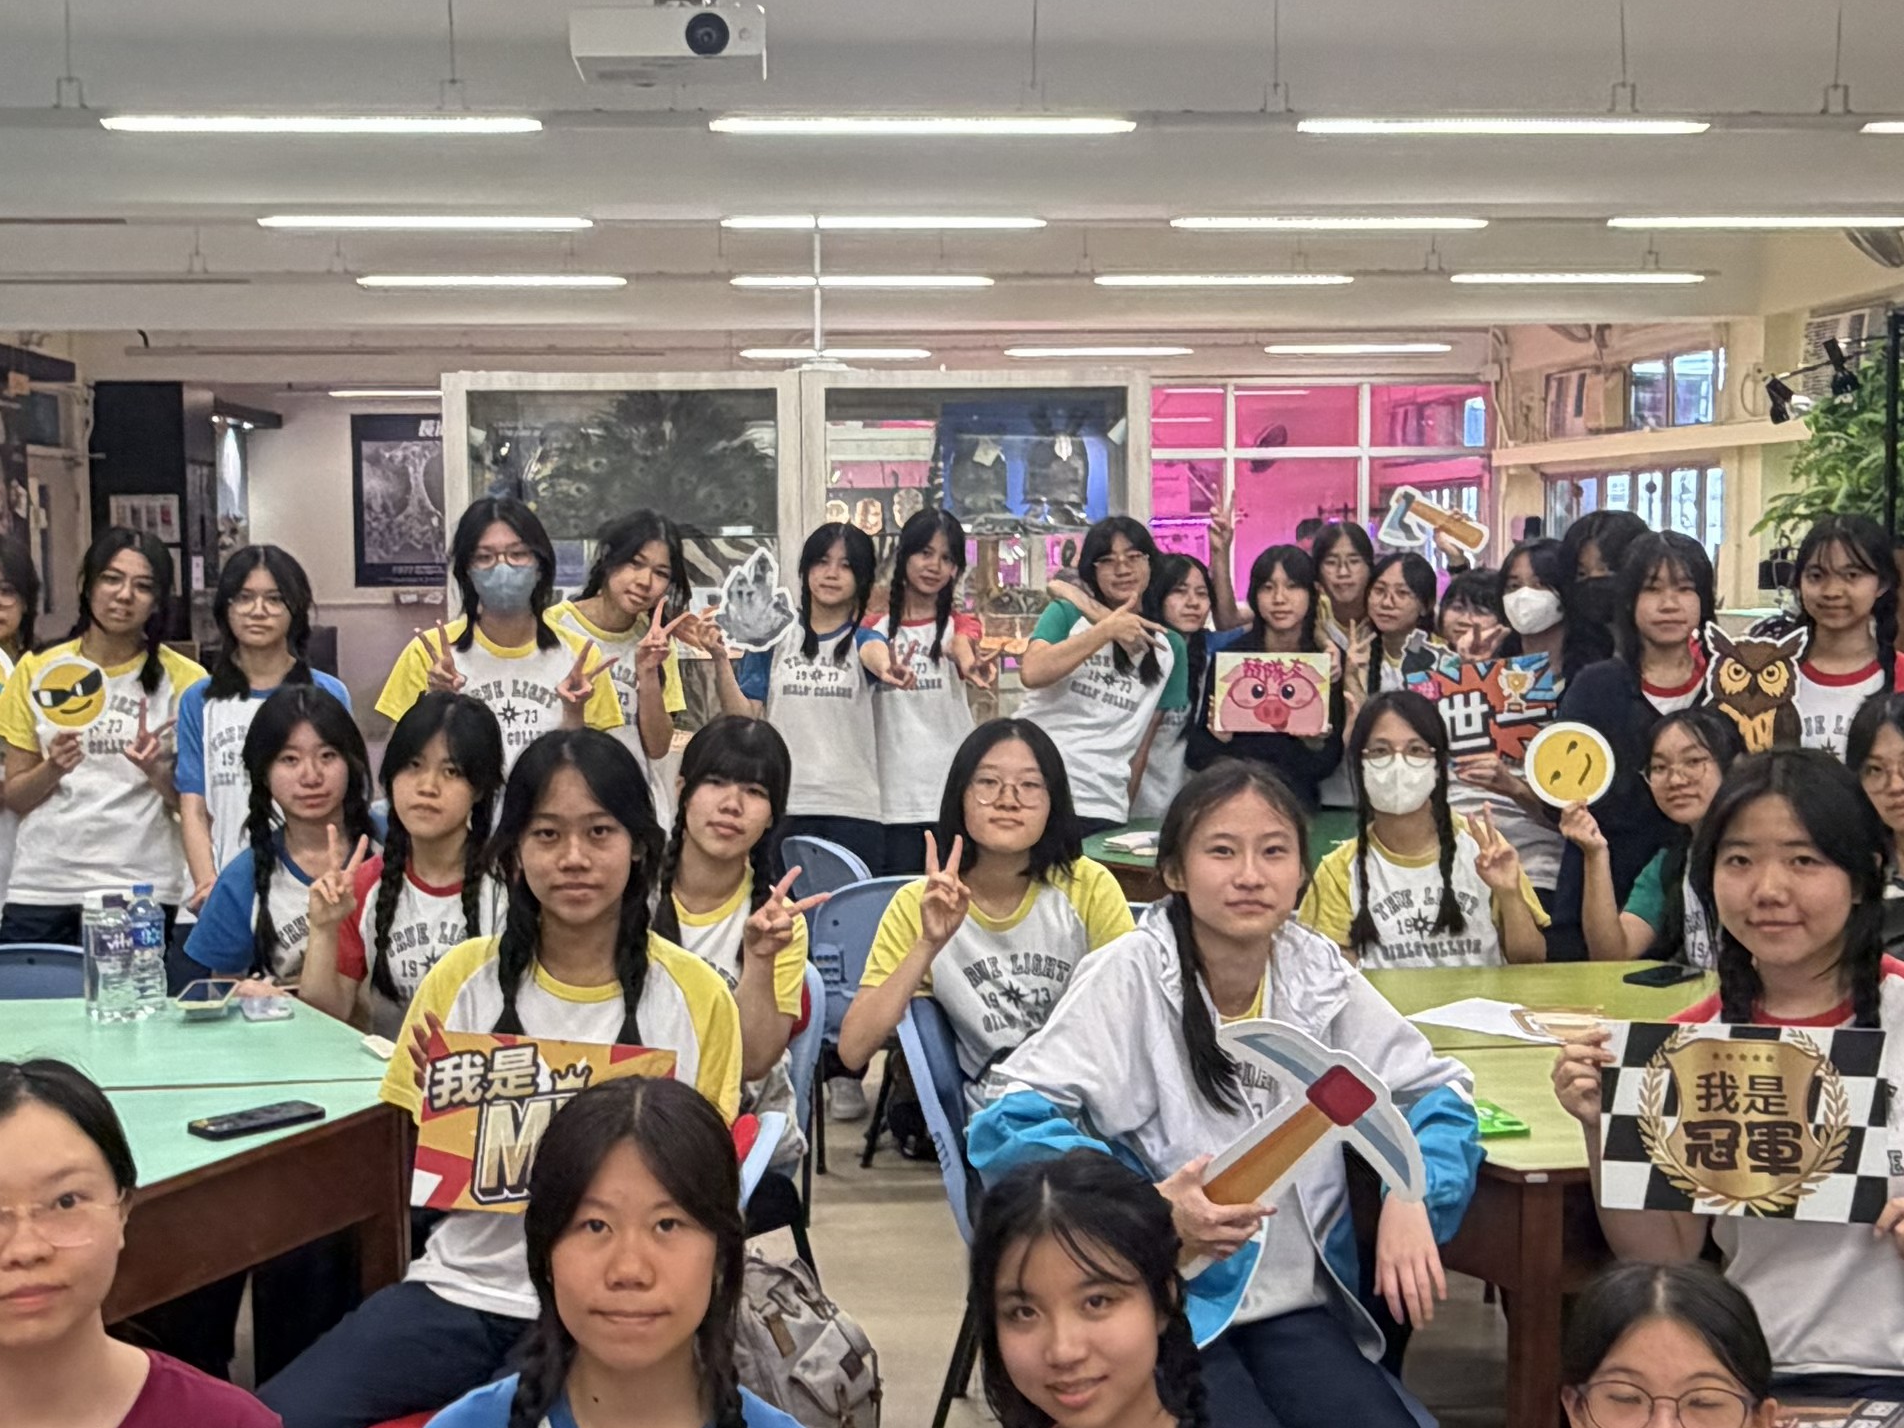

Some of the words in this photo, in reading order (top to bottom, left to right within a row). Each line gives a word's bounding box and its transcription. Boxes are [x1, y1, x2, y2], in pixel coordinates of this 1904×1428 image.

[523, 709, 539, 725] 73
[1396, 918, 1414, 935] 19
[400, 959, 418, 978] 19
[1010, 951, 1072, 983] LIGHT
[1030, 986, 1052, 1008] 73
[431, 1044, 540, 1112] 我是
[1696, 1070, 1789, 1117] 我是
[1682, 1119, 1804, 1176] 冠軍
